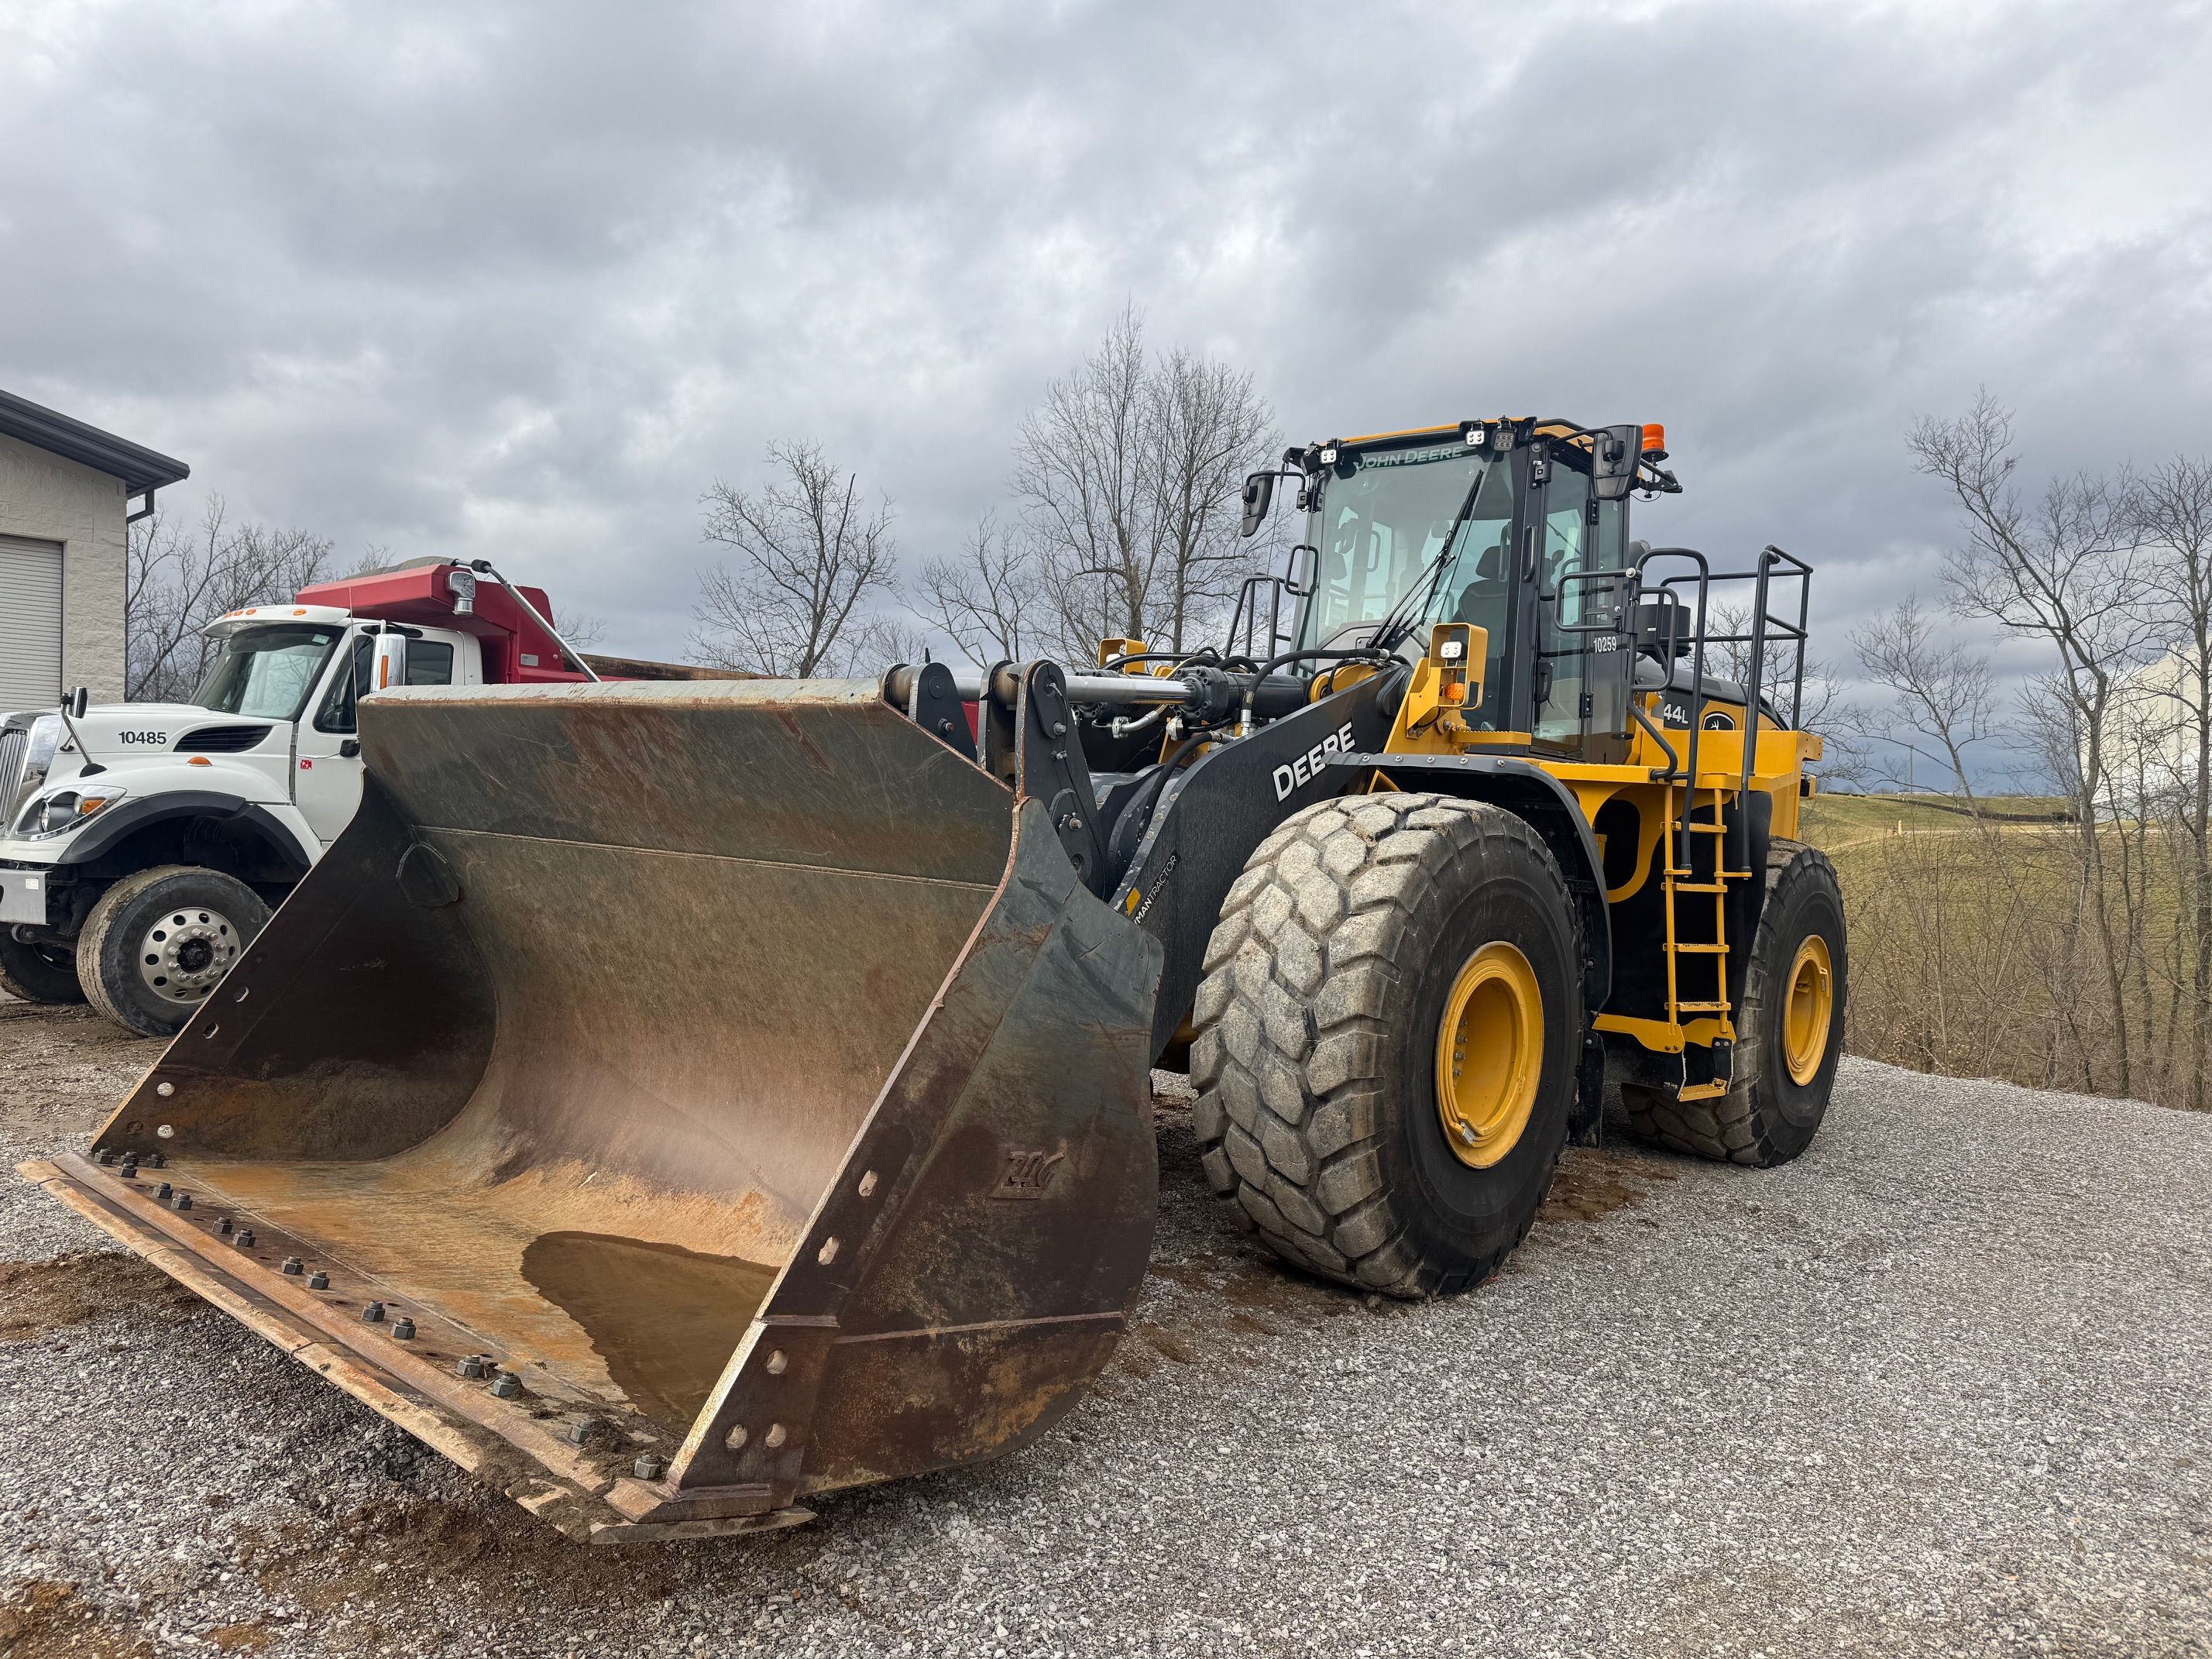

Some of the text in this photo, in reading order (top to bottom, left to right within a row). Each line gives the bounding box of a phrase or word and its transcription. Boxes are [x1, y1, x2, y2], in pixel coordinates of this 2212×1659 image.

[1356, 445, 1464, 471] JOHN DEERE
[1593, 636, 1616, 653] 10259
[118, 731, 167, 744] 10485
[1273, 721, 1355, 802] DEERE
